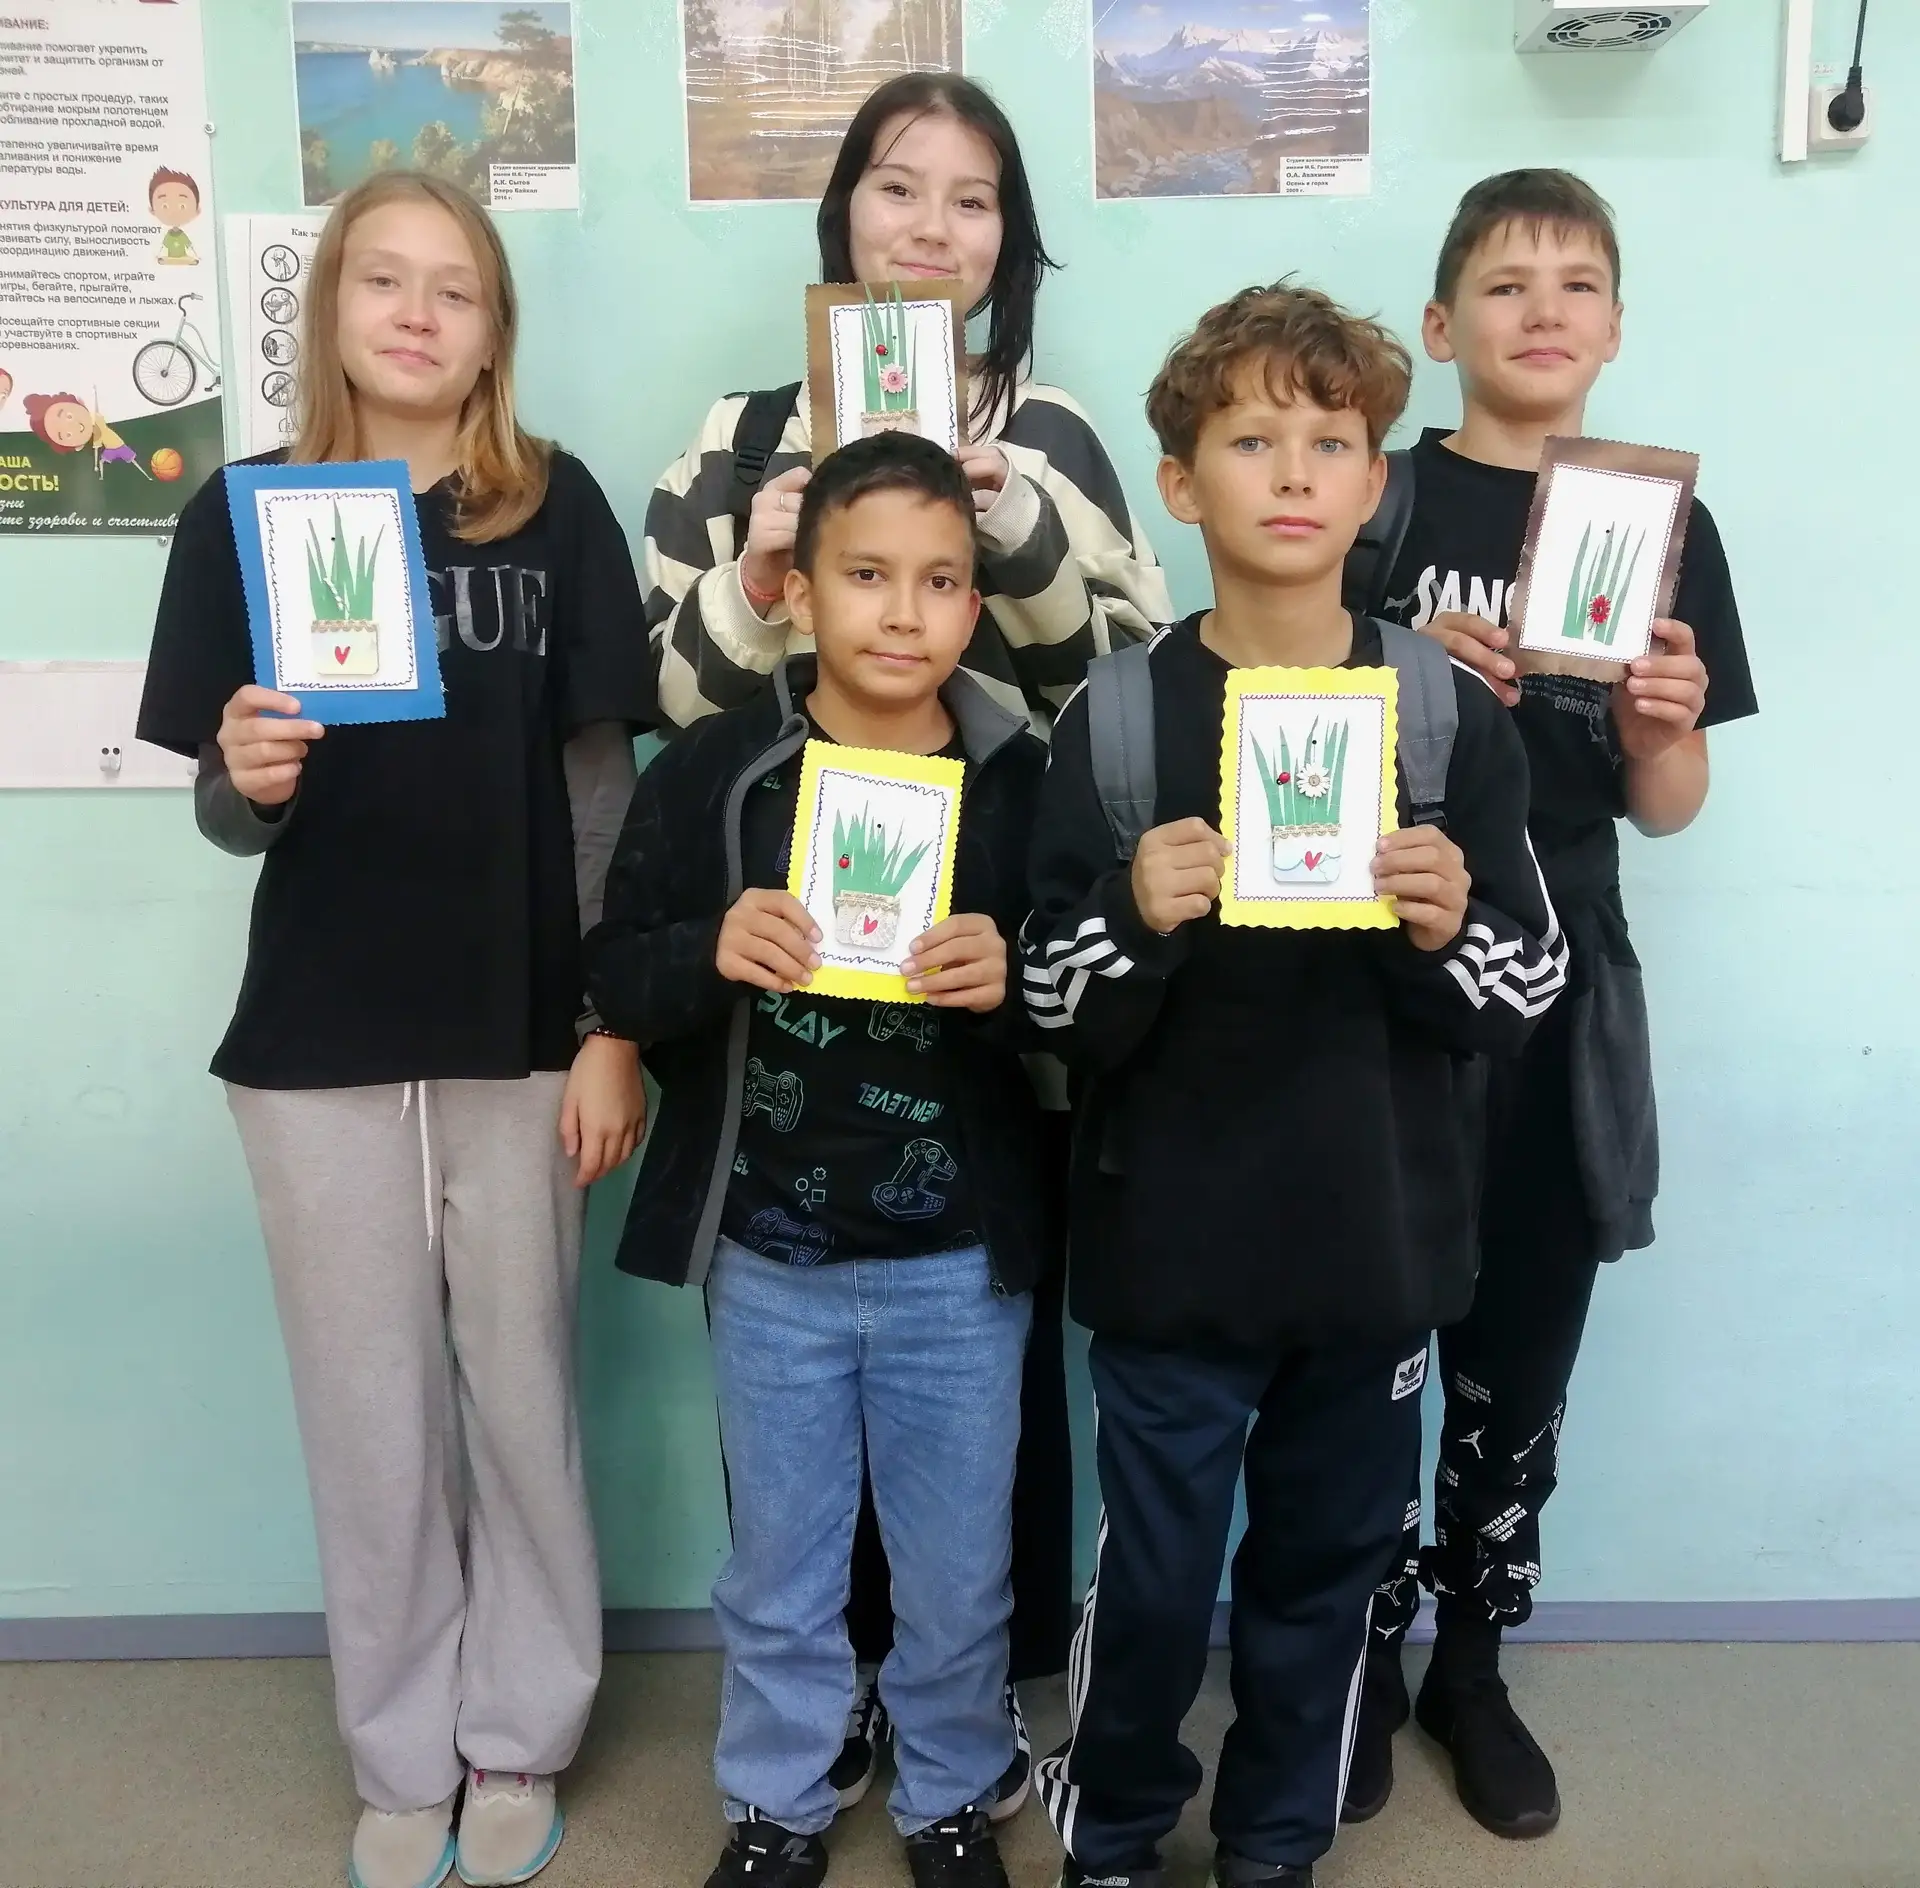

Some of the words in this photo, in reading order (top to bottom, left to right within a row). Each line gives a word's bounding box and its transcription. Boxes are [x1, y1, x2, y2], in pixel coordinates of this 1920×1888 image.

[45, 43, 96, 53] помогает
[98, 45, 148, 55] укрепить
[33, 56, 41, 64] и
[43, 56, 96, 67] защитить
[98, 57, 149, 68] организм
[151, 59, 164, 67] от
[23, 92, 31, 100] с
[33, 91, 79, 103] простых
[81, 94, 136, 105] процедур,
[139, 95, 169, 104] таких
[57, 105, 101, 116] мокрым
[103, 106, 169, 117] полотенцем
[0, 114, 59, 125] обливание
[61, 117, 127, 128] прохладной
[129, 118, 165, 129] водой.
[46, 141, 122, 152] увеличивайте
[125, 143, 159, 154] время
[52, 154, 60, 162] и
[62, 154, 122, 164] понижение
[0, 165, 53, 176] пературы
[55, 166, 87, 176] воды.
[58, 201, 84, 213] ДЛЯ
[86, 200, 130, 214] ДЕТЕЙ:
[0, 223, 31, 232] нятия
[33, 220, 109, 235] физкультурой
[111, 225, 162, 235] помогают
[291, 227, 309, 237] Как
[0, 235, 42, 245] звивать
[44, 236, 72, 247] силу,
[74, 236, 151, 246] выносливость
[73, 248, 129, 259] движений.
[63, 271, 111, 282] спортом,
[113, 271, 156, 283] играйте
[0, 282, 29, 292] игры,
[31, 281, 77, 293] бегайте,
[79, 283, 132, 294] прыгайте,
[47, 295, 61, 303] на
[63, 295, 127, 306] велосипеде
[139, 297, 177, 305] лыжах.
[0, 316, 55, 328] осещайте
[57, 319, 121, 329] спортивные
[123, 320, 160, 330] секции
[4, 328, 64, 340] участвуйте
[66, 330, 73, 339] в
[75, 330, 138, 341] спортивных
[0, 340, 80, 351] оревнованиях.
[0, 473, 60, 492] ОСТЬ!
[27, 512, 88, 530] здоровы
[91, 516, 104, 527] и
[858, 1082, 913, 1118] LEVEL
[907, 1098, 945, 1124] NEW
[1395, 1376, 1421, 1396] adidas
[1502, 1502, 1521, 1519] FOR
